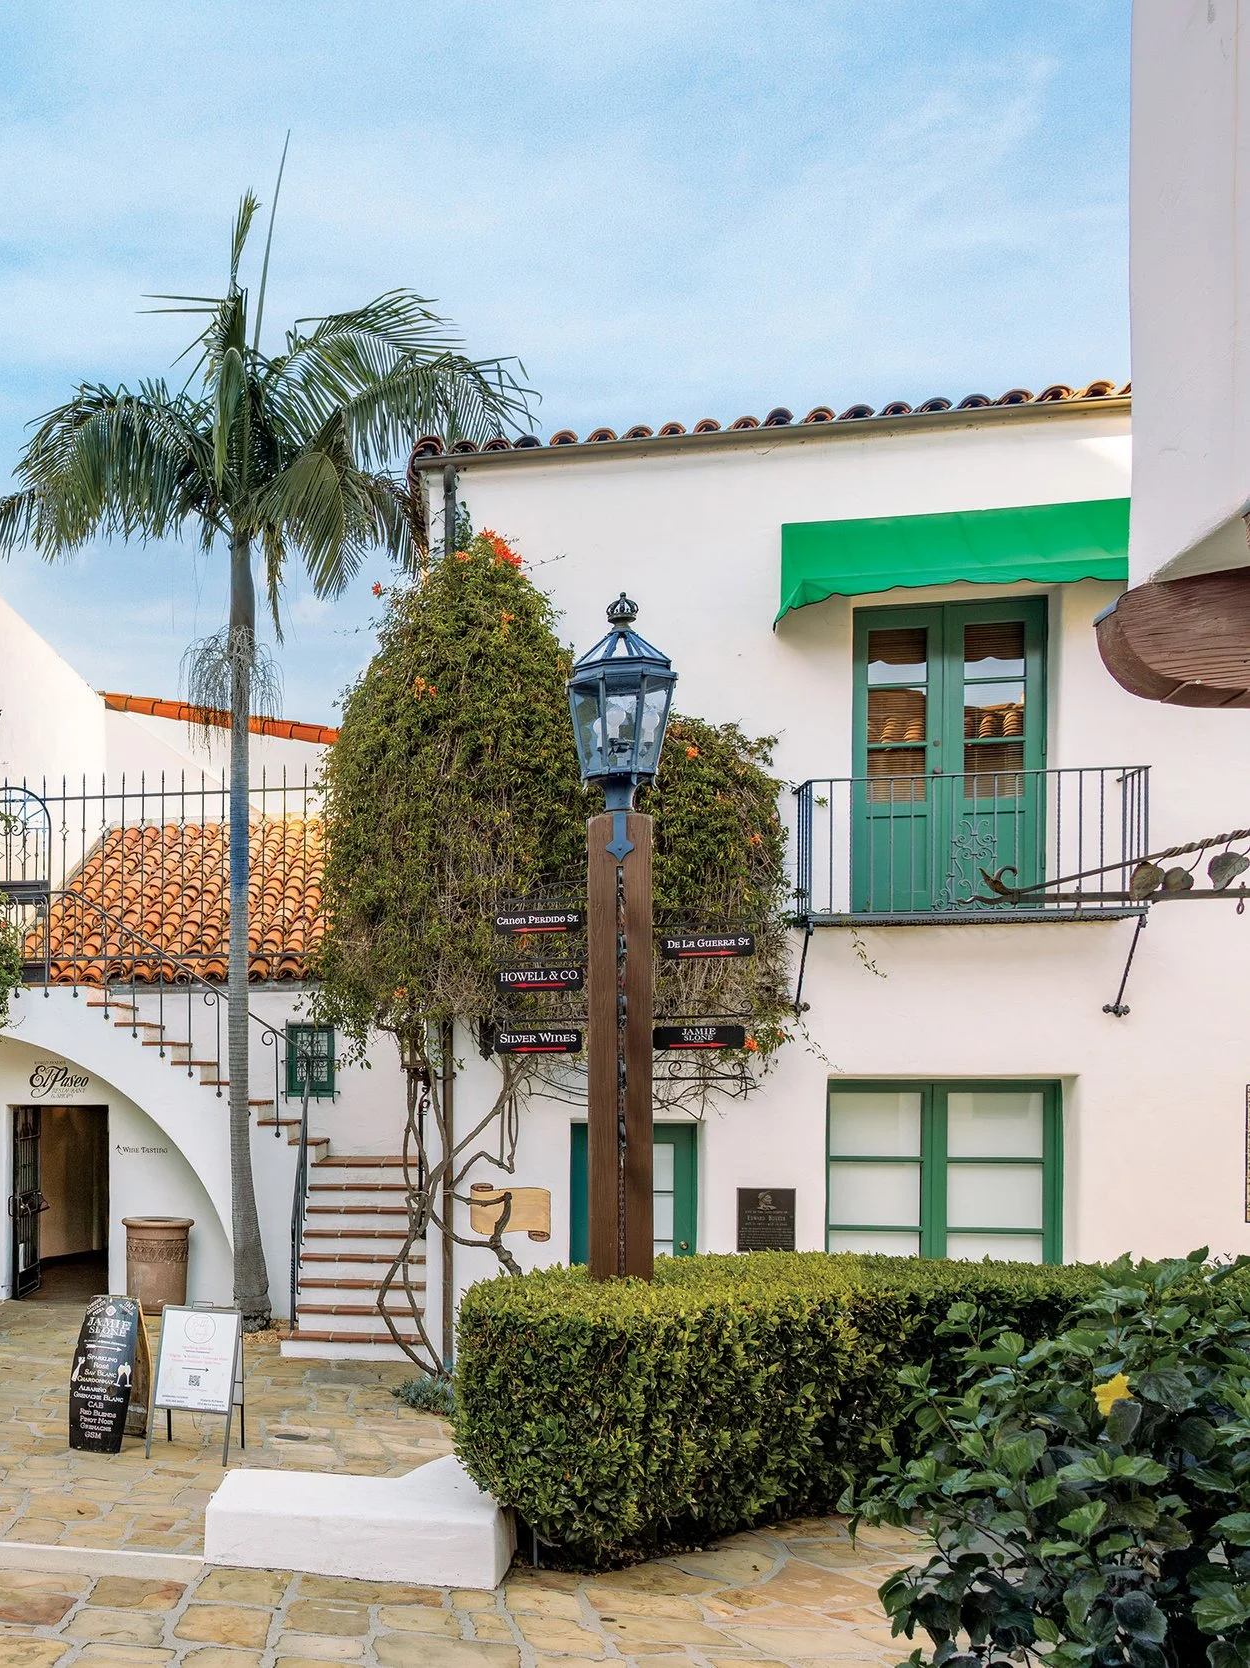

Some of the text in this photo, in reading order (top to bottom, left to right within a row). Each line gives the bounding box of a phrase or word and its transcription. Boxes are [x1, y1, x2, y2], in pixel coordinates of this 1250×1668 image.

[500, 970, 579, 982] HOWELL & CO.
[681, 1027, 717, 1036] JAMIE
[499, 1032, 577, 1044] SILVER WINES
[30, 1065, 89, 1098] El Paseo
[87, 1316, 132, 1332] JAMIE
[88, 1325, 127, 1338] SLONE
[87, 1400, 104, 1409] CAB
[84, 1430, 102, 1440] GSM
